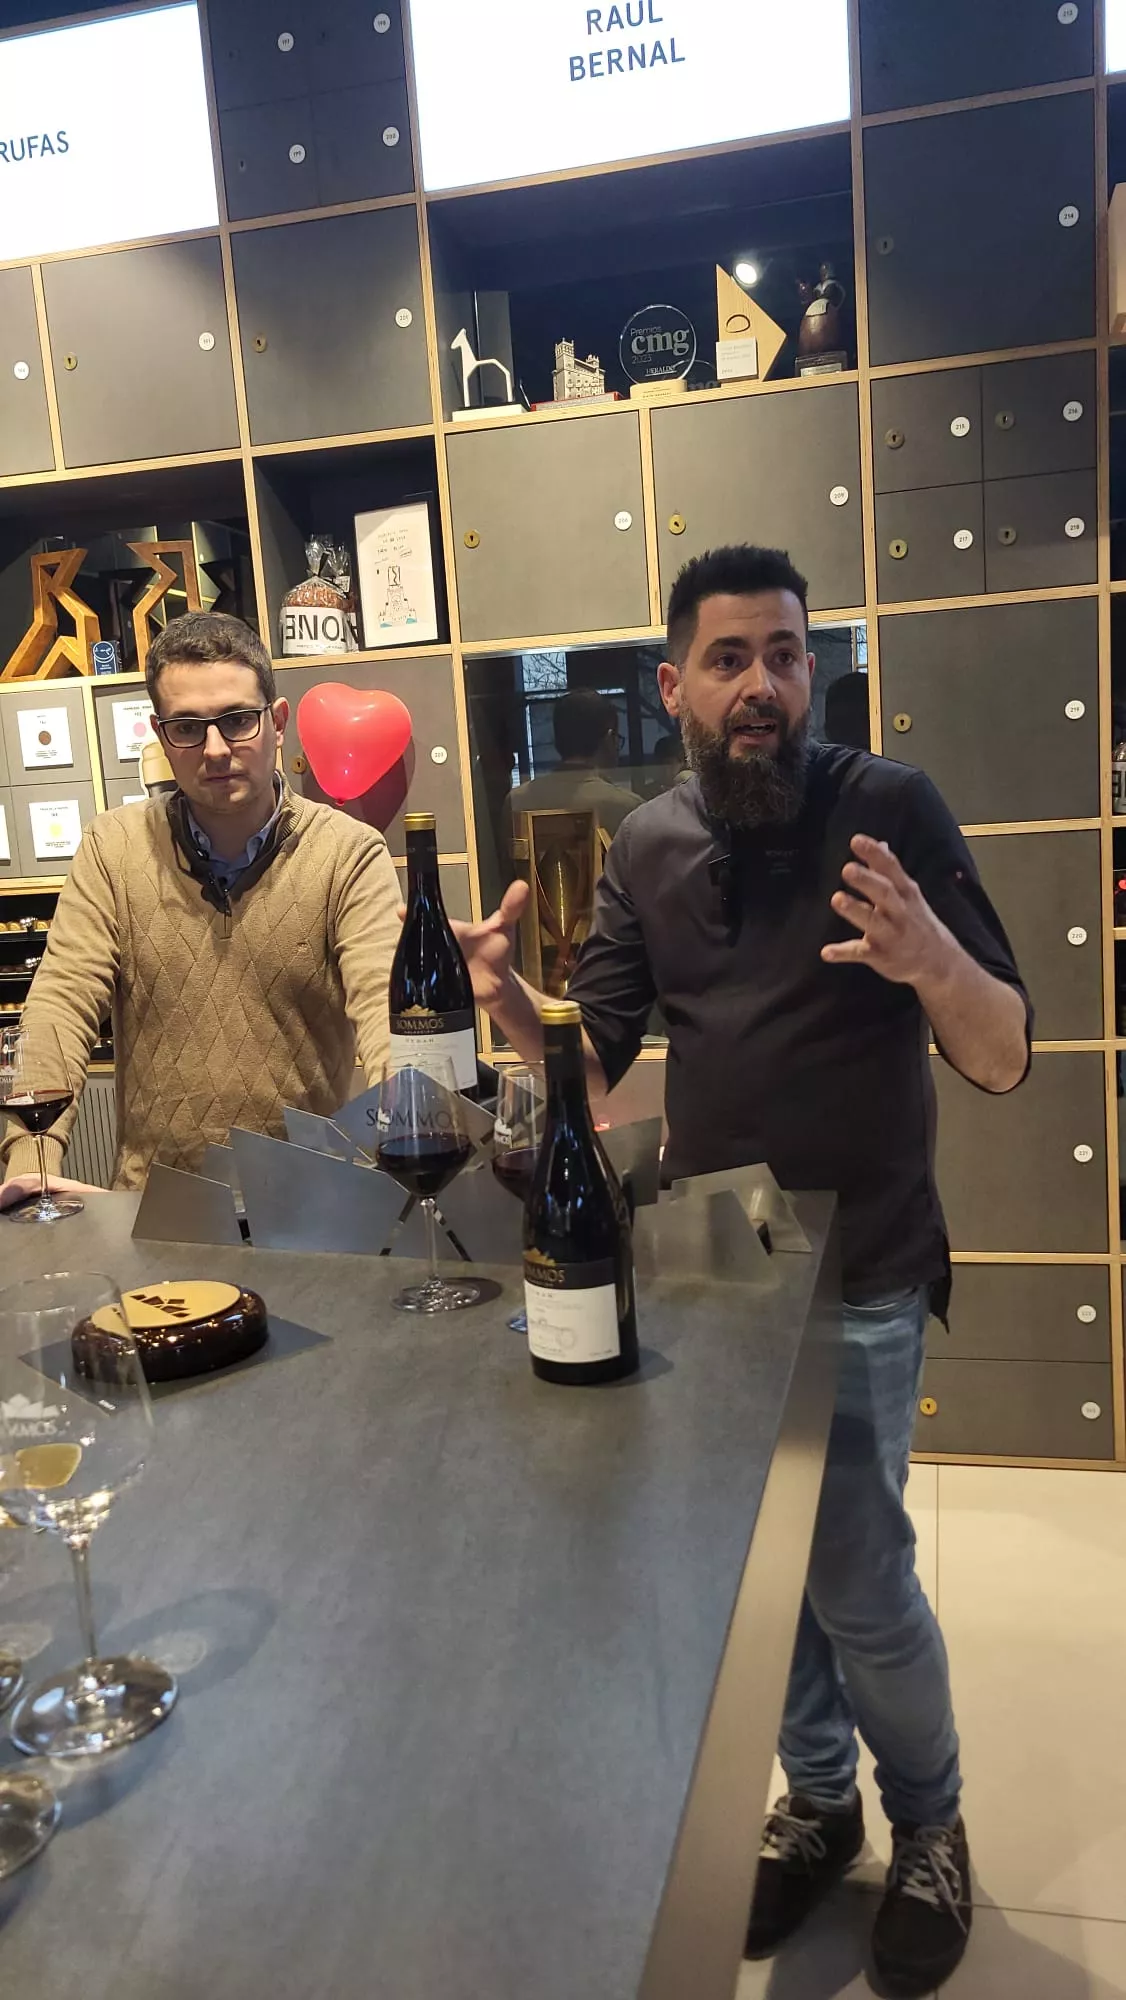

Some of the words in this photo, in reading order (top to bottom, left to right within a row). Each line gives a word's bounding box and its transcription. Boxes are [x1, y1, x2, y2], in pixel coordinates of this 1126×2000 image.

[586, 0, 663, 35] RAUL
[569, 37, 686, 81] BERNAL
[1063, 212, 1074, 220] 214
[631, 329, 690, 356] cmg
[396, 1018, 445, 1030] SOMMOS
